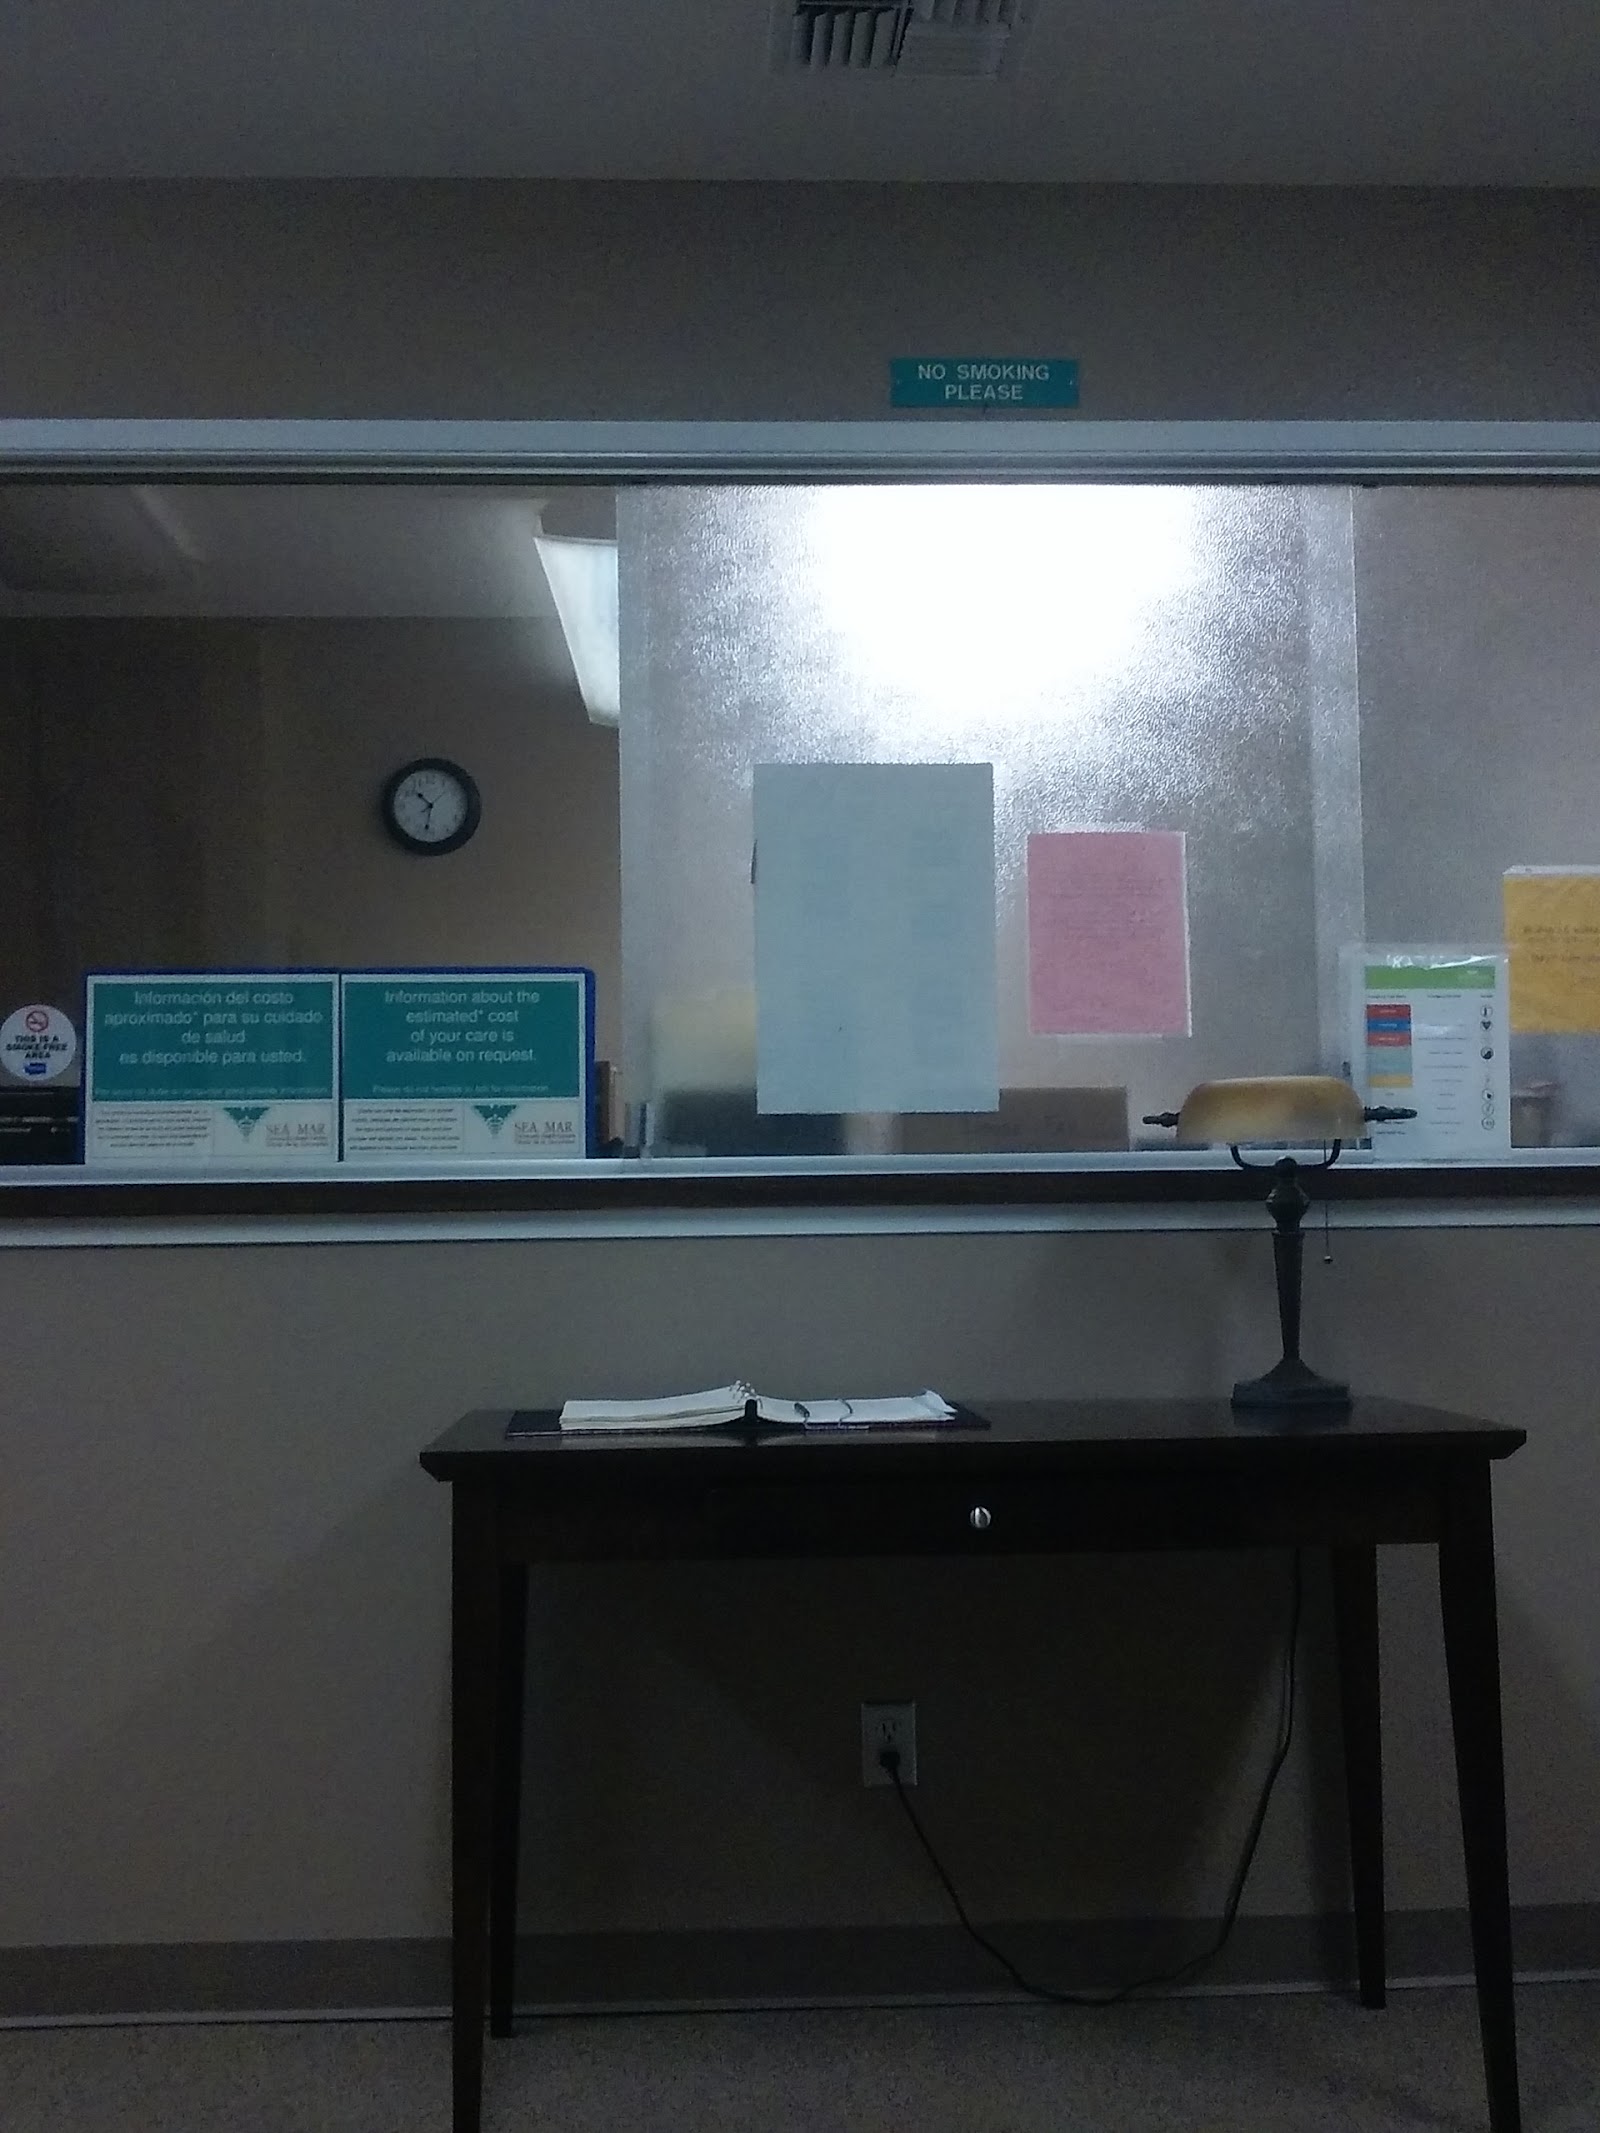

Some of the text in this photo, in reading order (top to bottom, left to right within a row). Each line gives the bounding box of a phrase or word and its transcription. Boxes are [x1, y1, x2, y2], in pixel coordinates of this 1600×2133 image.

[918, 363, 1050, 381] NO SMOKING
[944, 384, 1024, 401] PLEASE
[134, 990, 294, 1005] Información del costo
[385, 990, 540, 1005] Information about the
[204, 1013, 237, 1026] para
[242, 1012, 260, 1024] su
[264, 1010, 323, 1024] cuidado
[488, 1010, 519, 1024] cost
[15, 1034, 59, 1043] THIS IS A
[181, 1030, 246, 1044] de salud
[411, 1029, 514, 1045] of your care is
[25, 1051, 51, 1059] AREA
[142, 1050, 219, 1067] disponible
[223, 1052, 256, 1066] para
[386, 1049, 452, 1063] available
[456, 1052, 475, 1063] on
[266, 1123, 326, 1135] SEA MAR
[515, 1121, 573, 1133] SEA MAR
